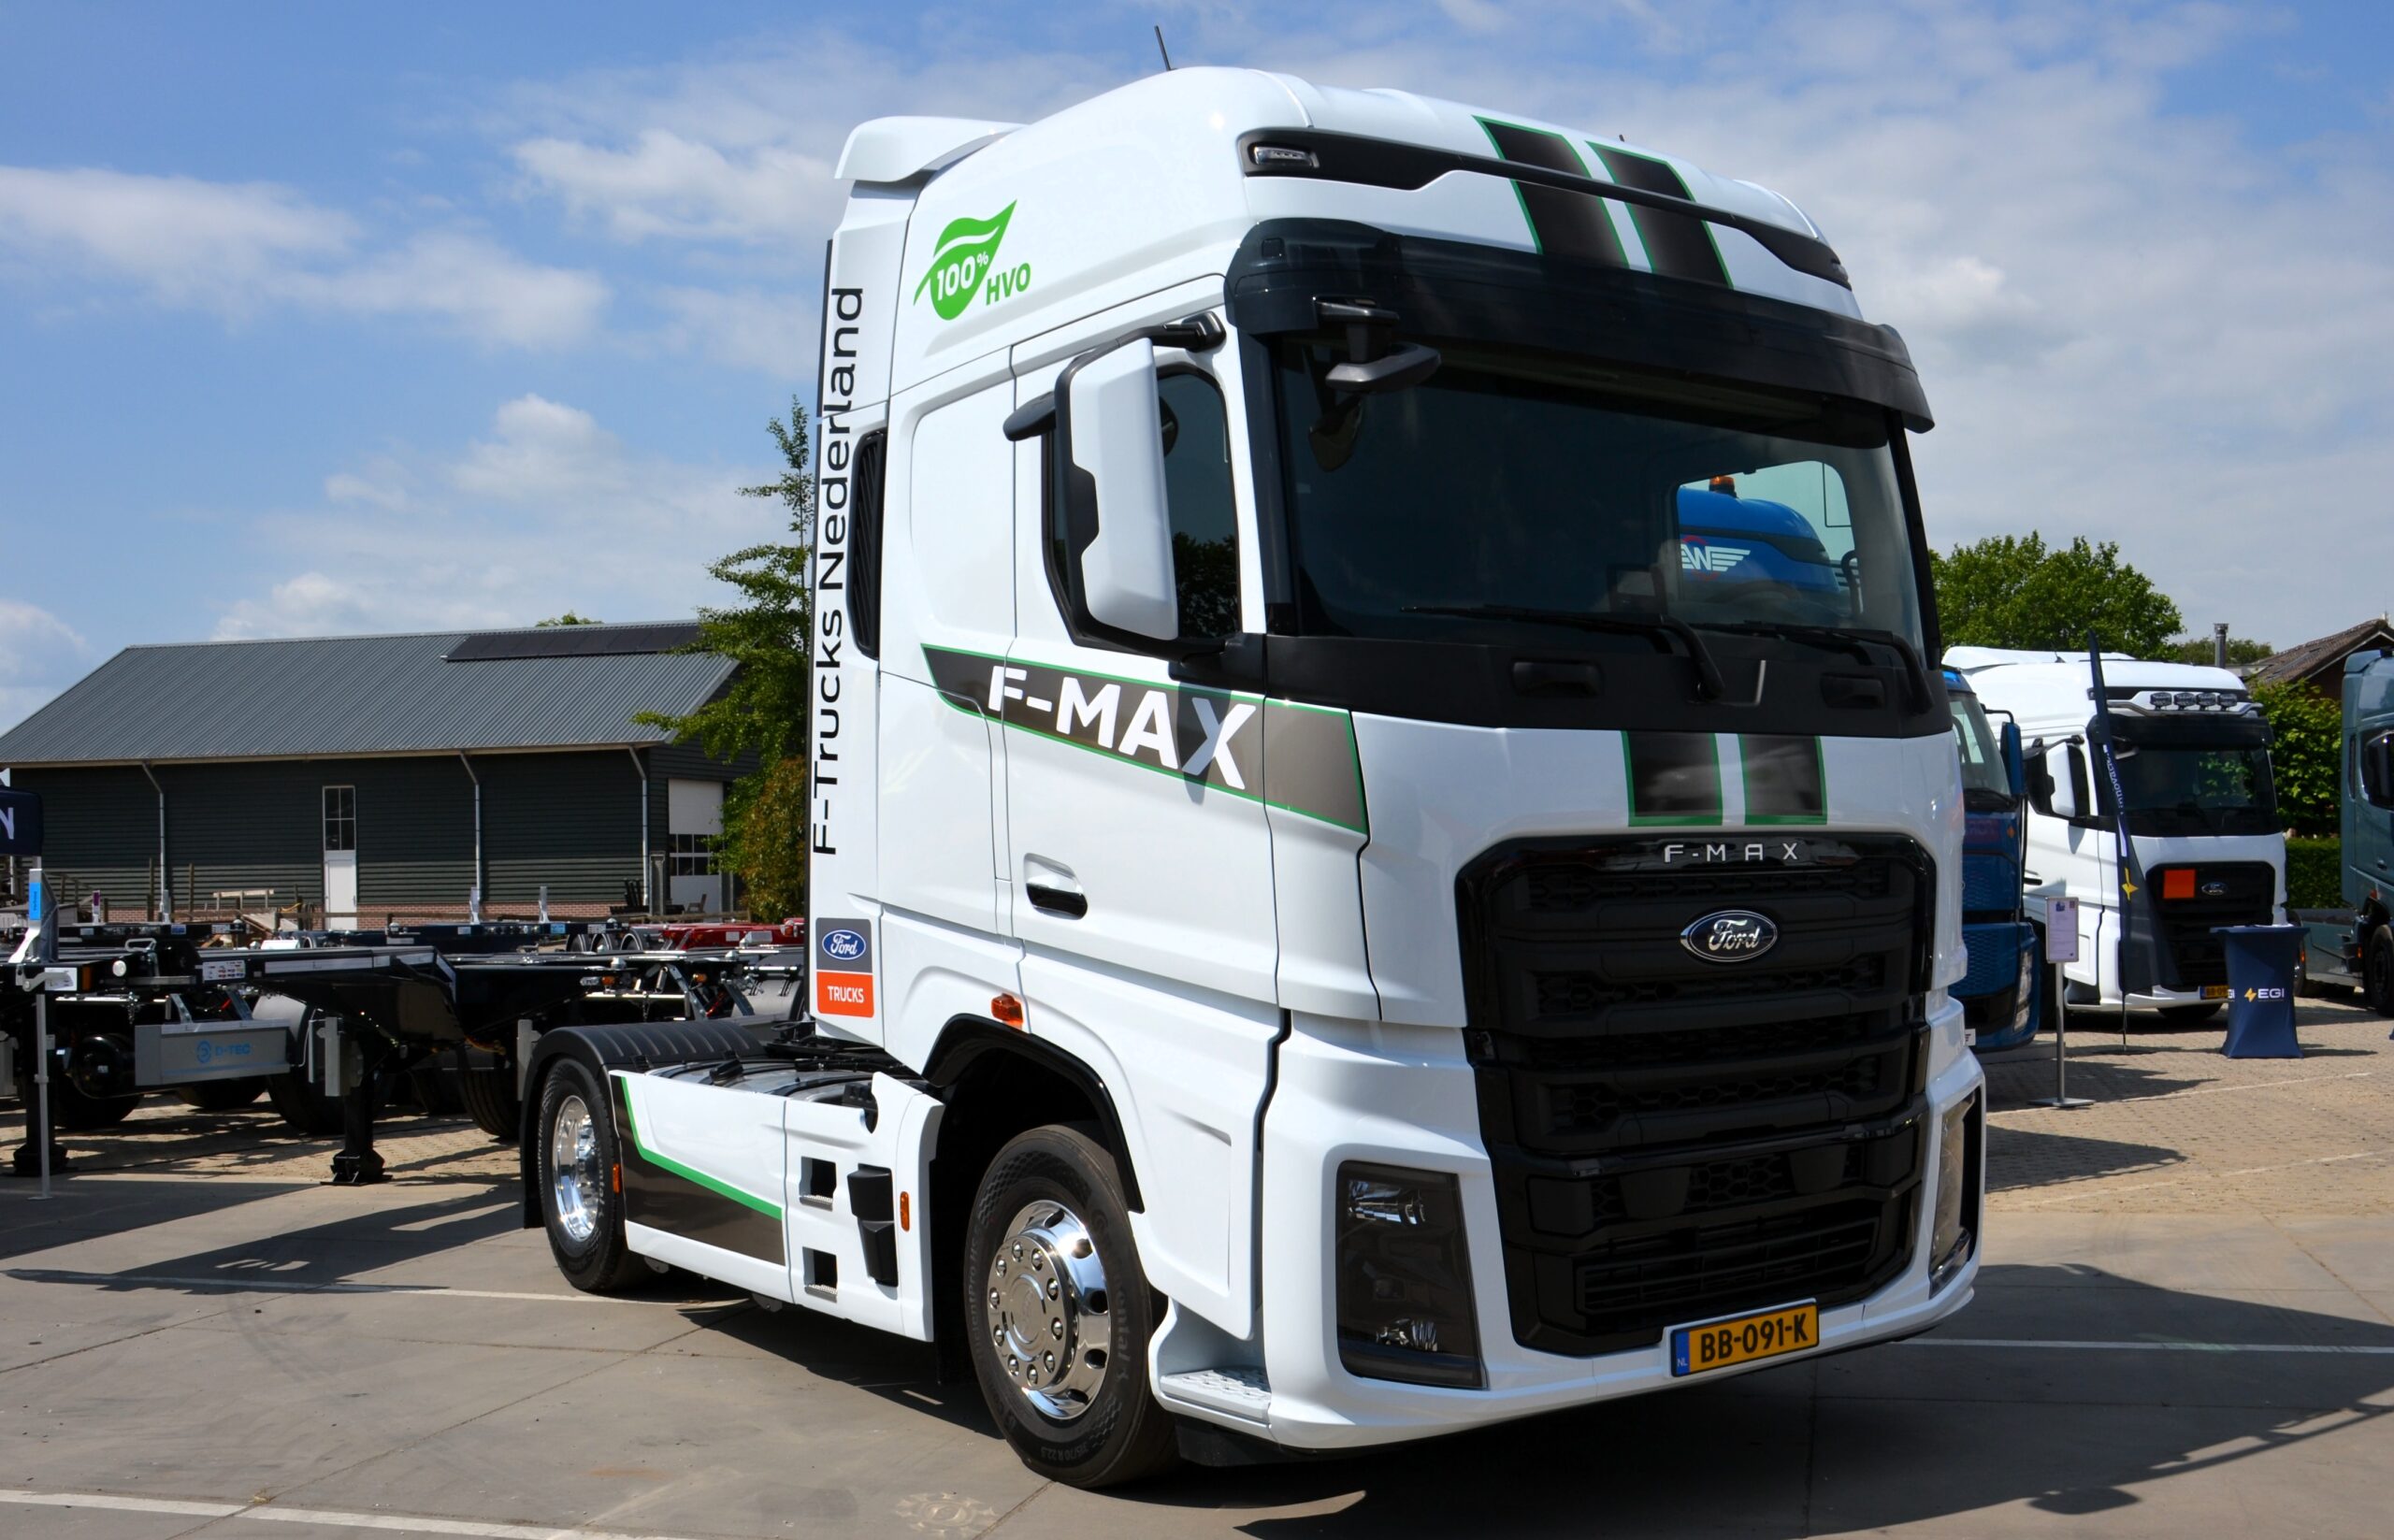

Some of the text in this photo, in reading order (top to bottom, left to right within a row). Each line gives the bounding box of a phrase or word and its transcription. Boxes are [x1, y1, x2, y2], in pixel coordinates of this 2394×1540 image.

[986, 262, 1031, 307] HVO
[813, 287, 863, 856] F-Trucks Nederland
[988, 665, 1257, 791] F-MAX
[1664, 842, 1798, 863] F-MAX
[829, 933, 858, 955] Ford
[1708, 918, 1761, 951] Ford
[827, 986, 865, 1003] TRUCKS
[2257, 987, 2285, 1000] EGI
[1700, 1313, 1809, 1364] BB-091-K
[1677, 1358, 1688, 1368] NL
